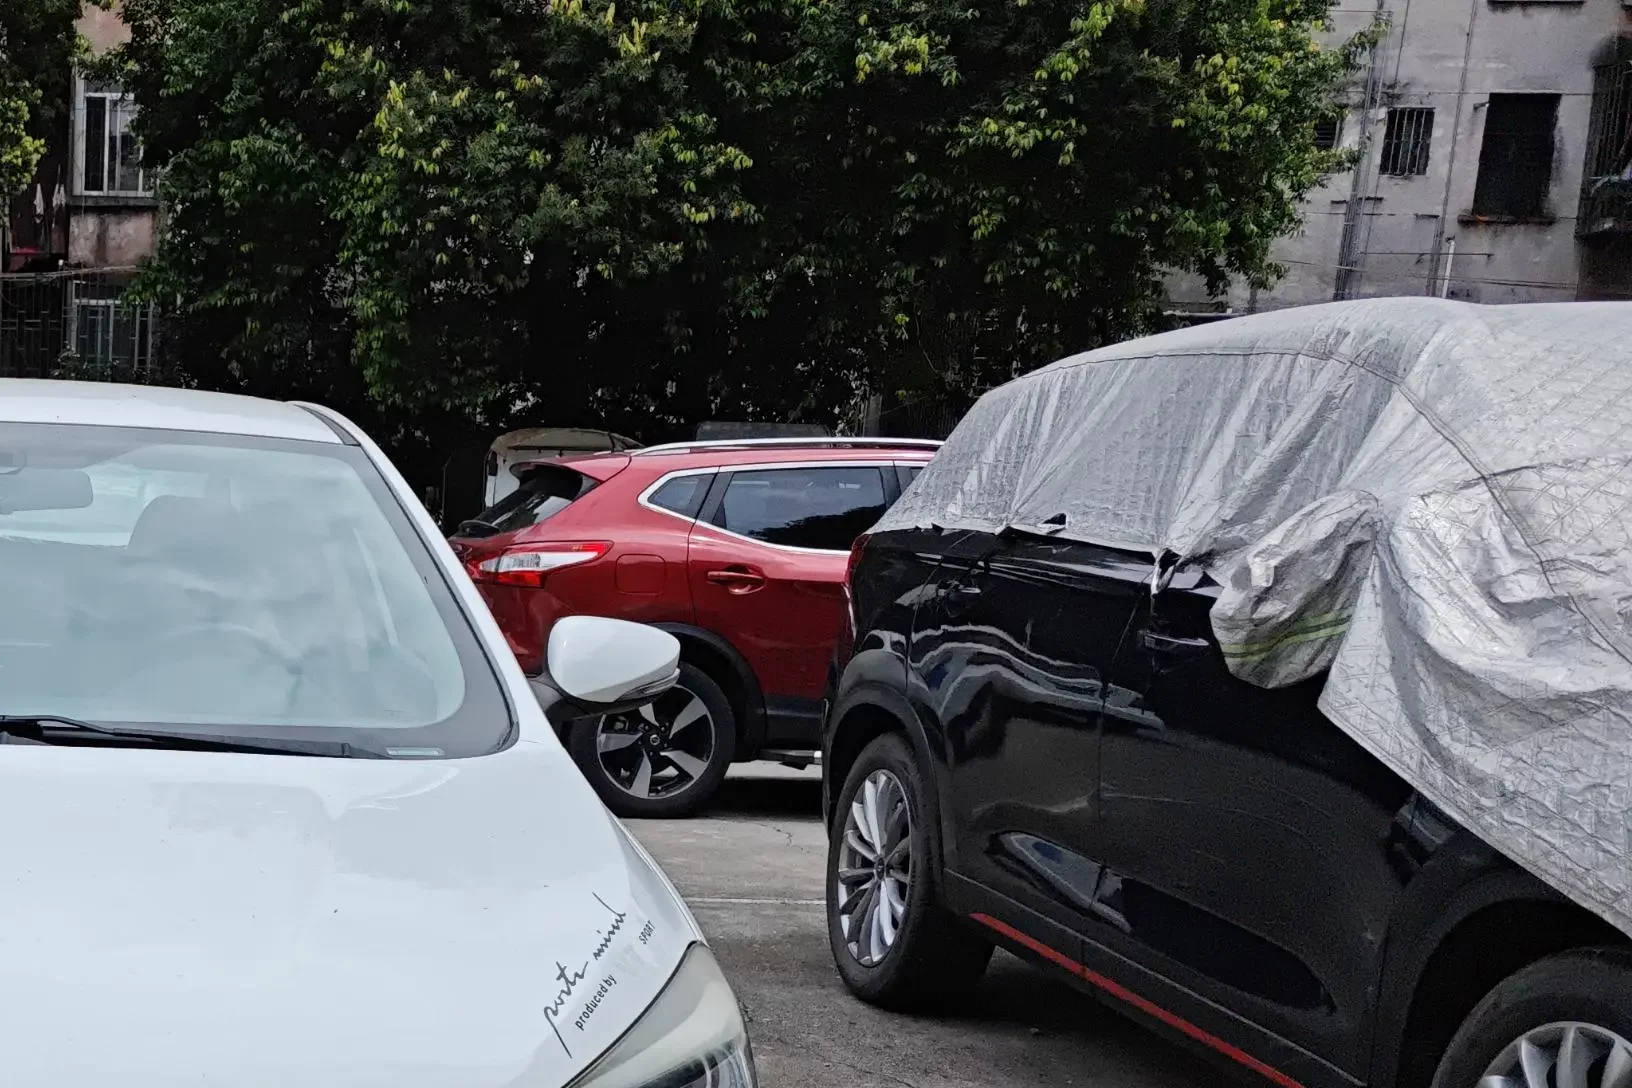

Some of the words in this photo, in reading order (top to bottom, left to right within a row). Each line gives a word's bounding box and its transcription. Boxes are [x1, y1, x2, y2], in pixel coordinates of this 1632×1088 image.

[574, 980, 608, 1031] produced
[607, 974, 618, 987] by
[638, 919, 657, 945] SPORT
